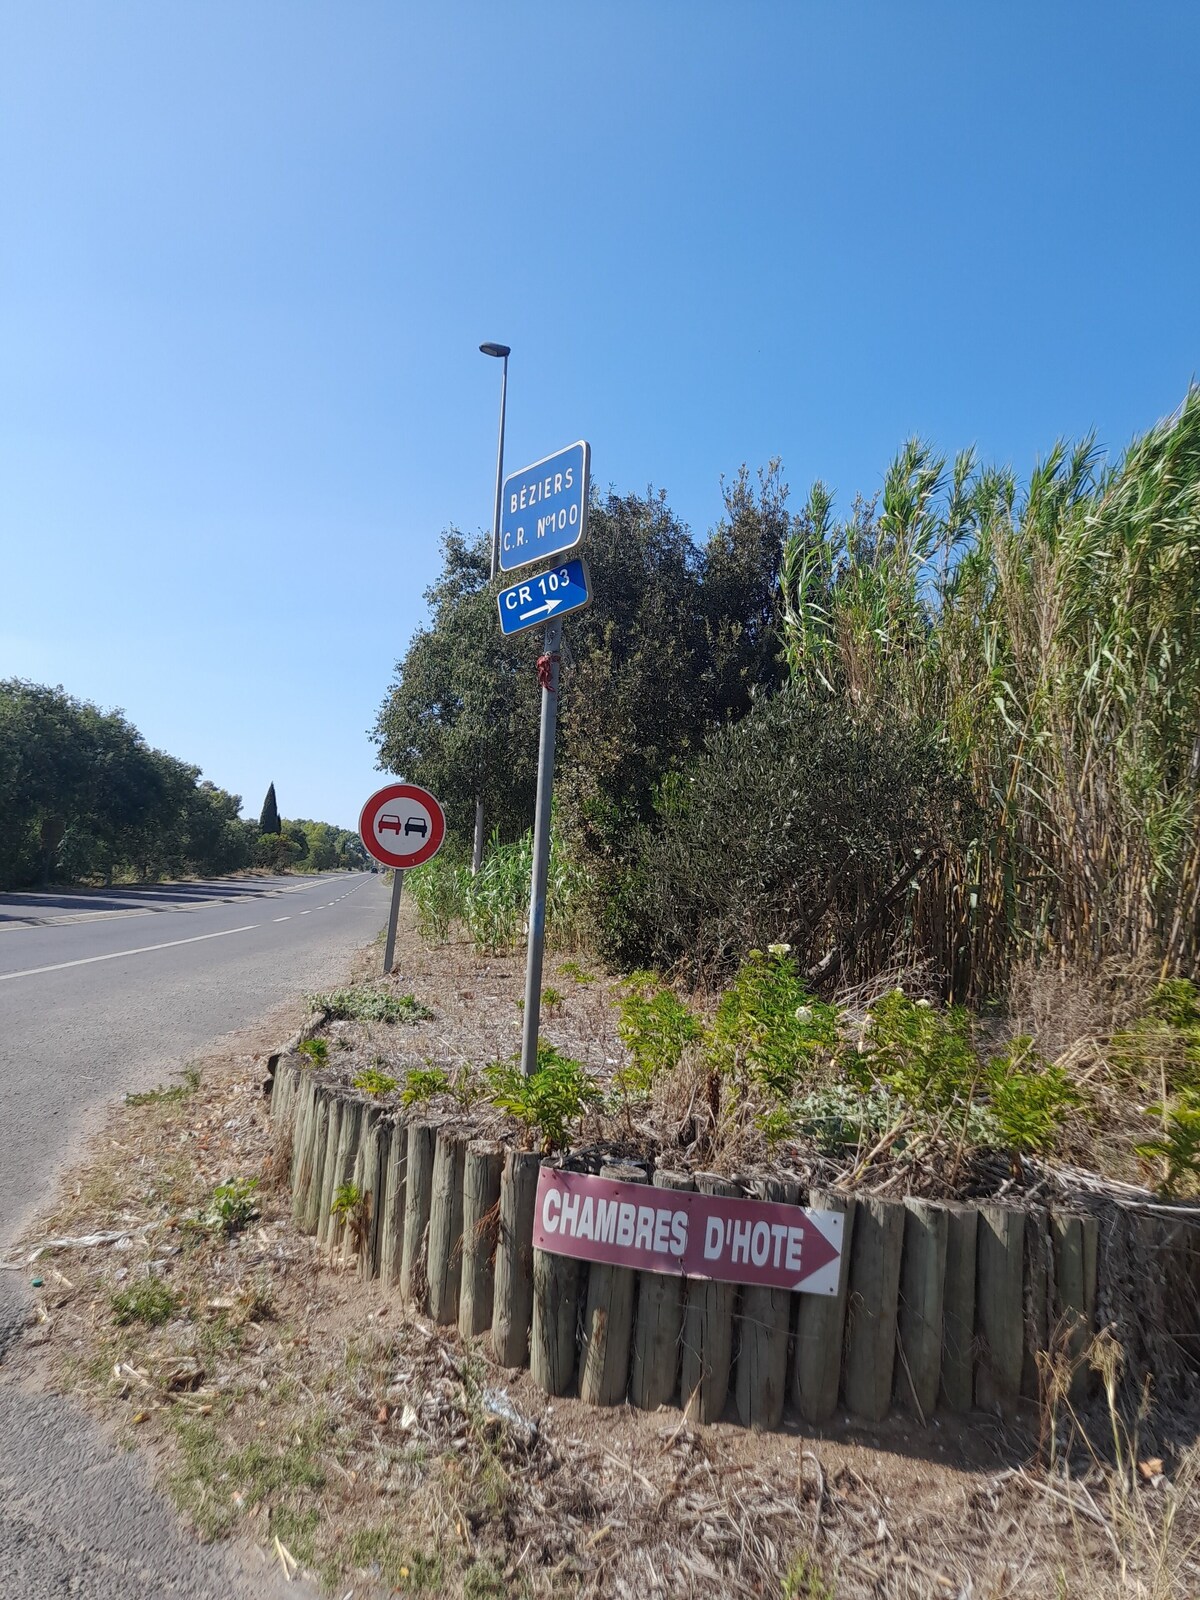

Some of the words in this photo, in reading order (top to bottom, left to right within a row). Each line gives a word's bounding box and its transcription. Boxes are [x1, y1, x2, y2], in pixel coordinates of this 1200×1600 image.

[510, 467, 574, 514] BÉZIERS
[503, 527, 529, 551] C.R.
[505, 585, 533, 610] CR
[538, 569, 571, 596] 103
[542, 1188, 689, 1256] CHAMBRES
[703, 1216, 805, 1272] D'HOTE
